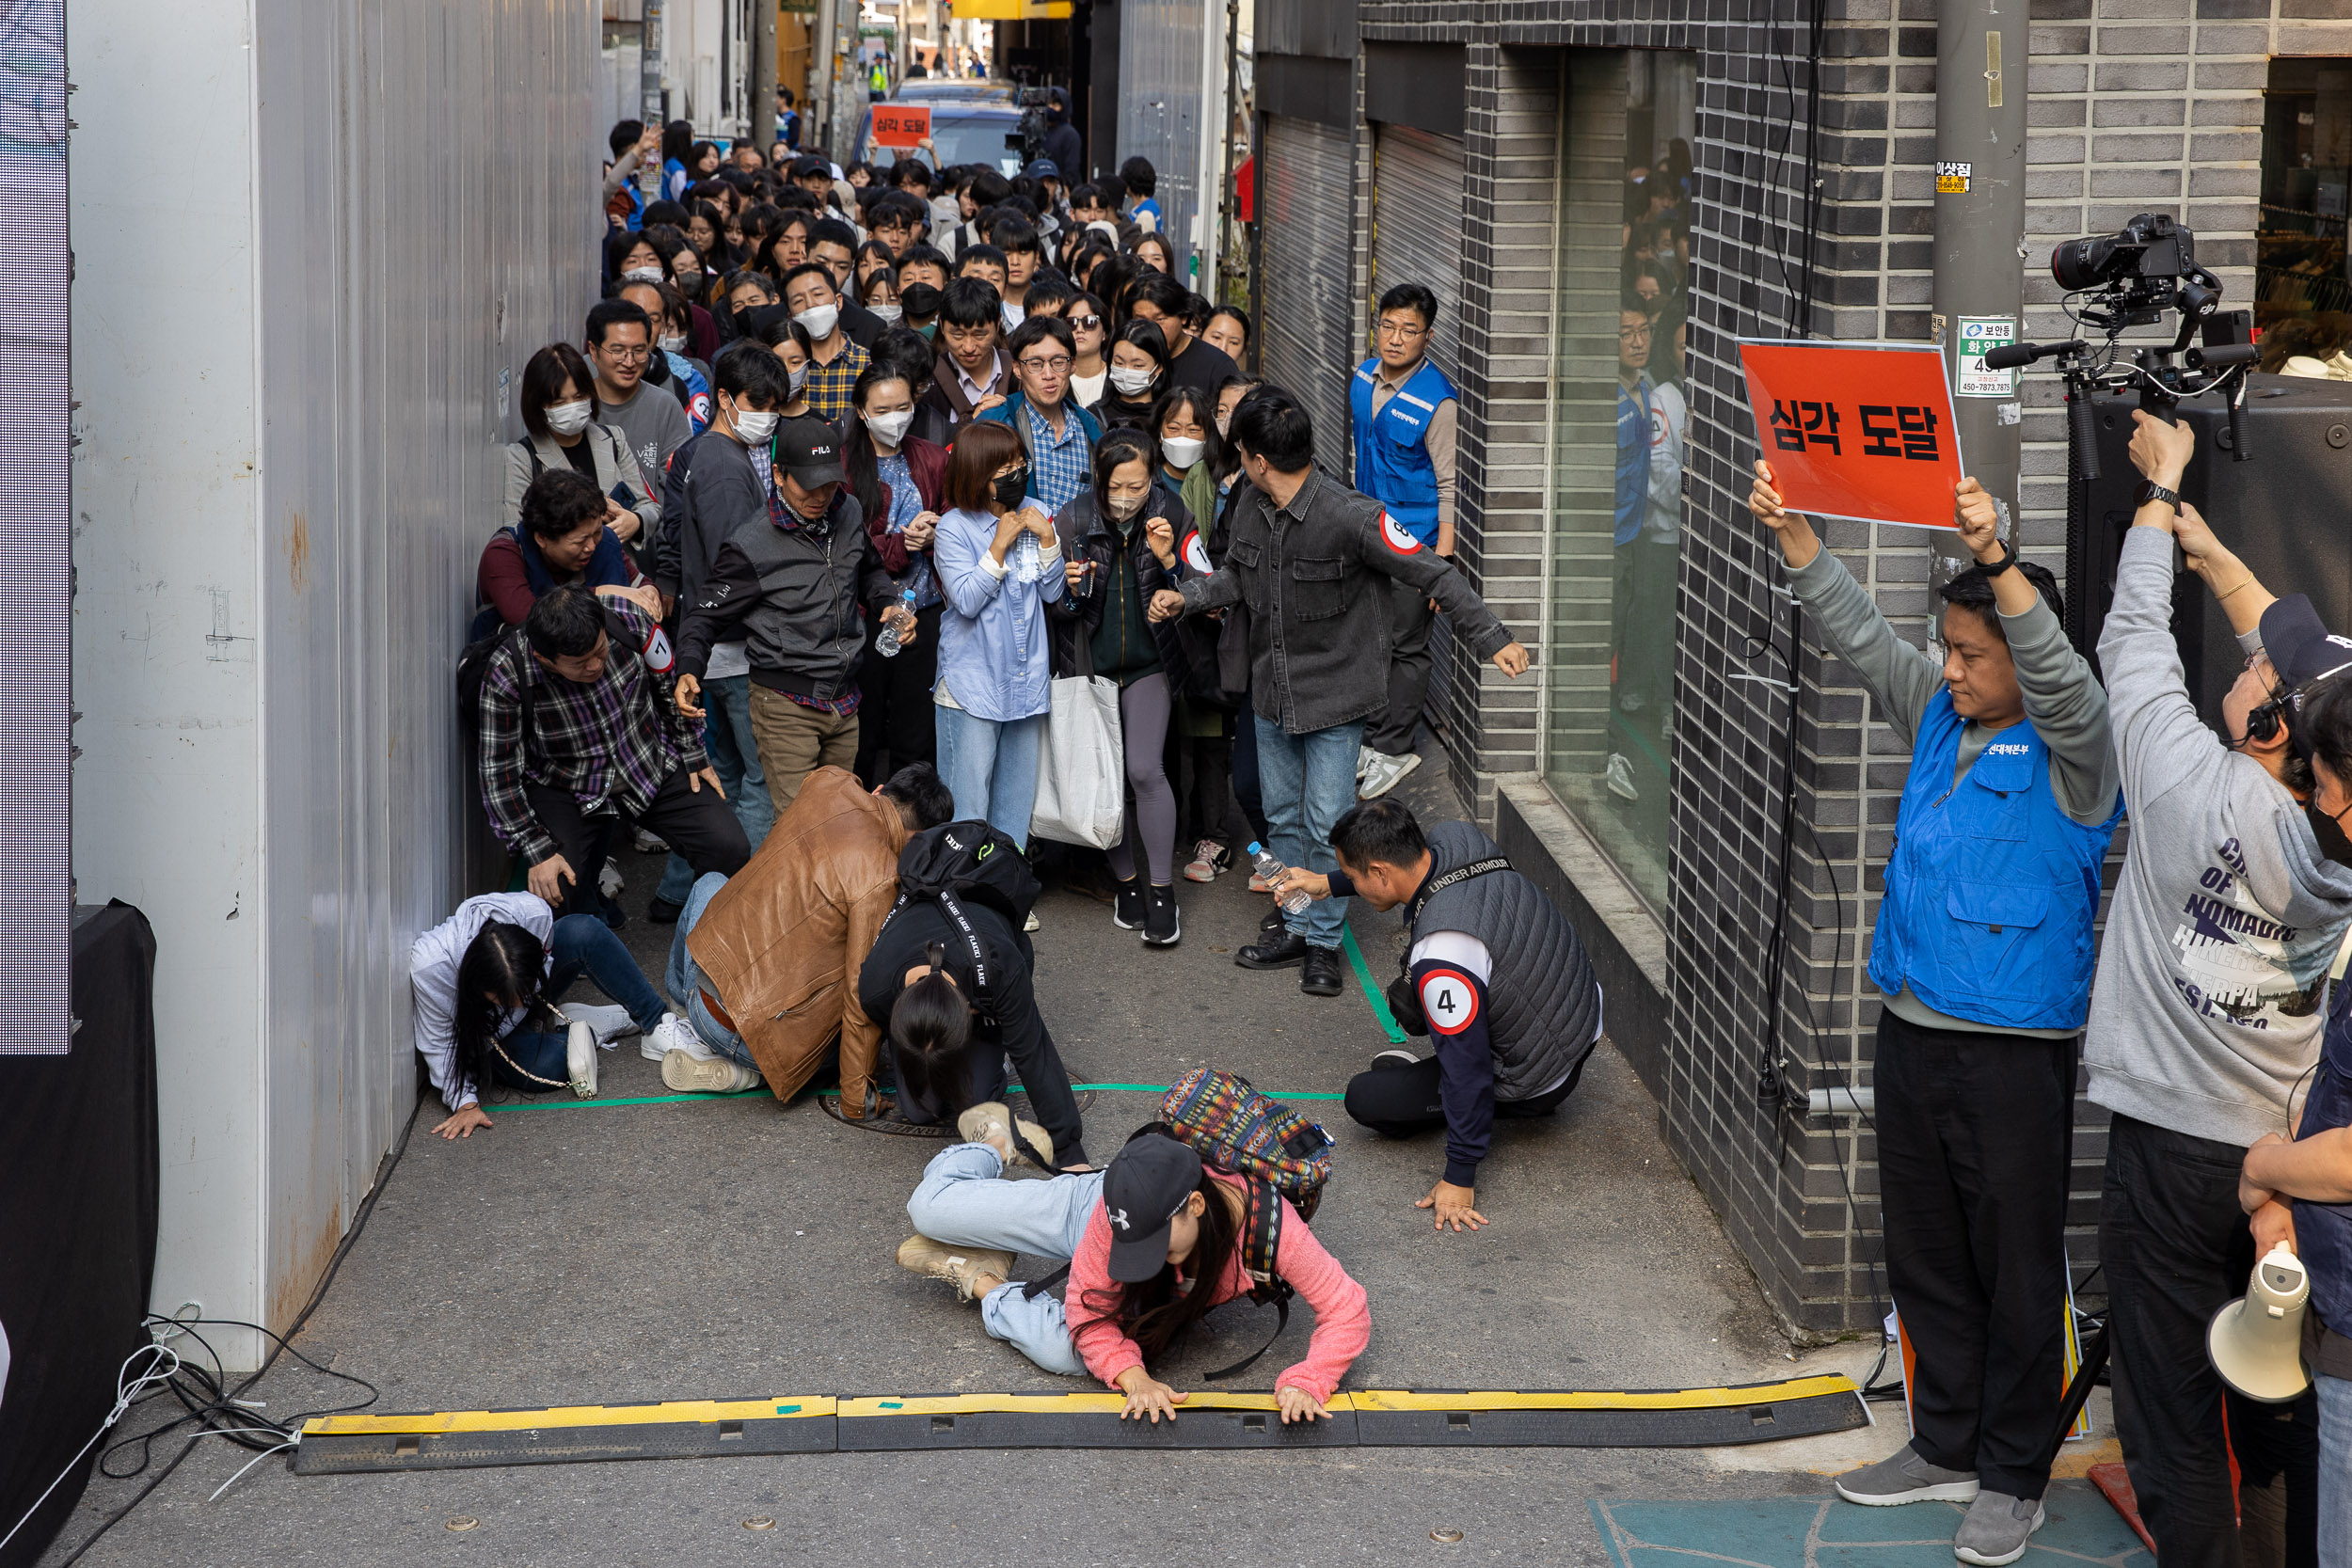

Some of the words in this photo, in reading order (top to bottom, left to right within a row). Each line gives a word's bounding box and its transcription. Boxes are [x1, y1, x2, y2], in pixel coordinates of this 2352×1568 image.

[877, 118, 898, 133] 심각
[903, 119, 926, 134] 도달
[1936, 161, 1971, 177] 이삿짐
[1985, 325, 2010, 336] 보안등
[1769, 399, 1841, 456] 심각
[1859, 404, 1939, 461] 도달
[811, 446, 831, 455] FILA
[1429, 869, 1470, 894] UNDER
[1467, 858, 1509, 876] ARMOUR
[2200, 866, 2233, 895] OF
[968, 935, 981, 958] FLAKIKI
[2171, 923, 2252, 971] HIKER
[2253, 955, 2272, 973] &
[1437, 990, 1456, 1014] 4
